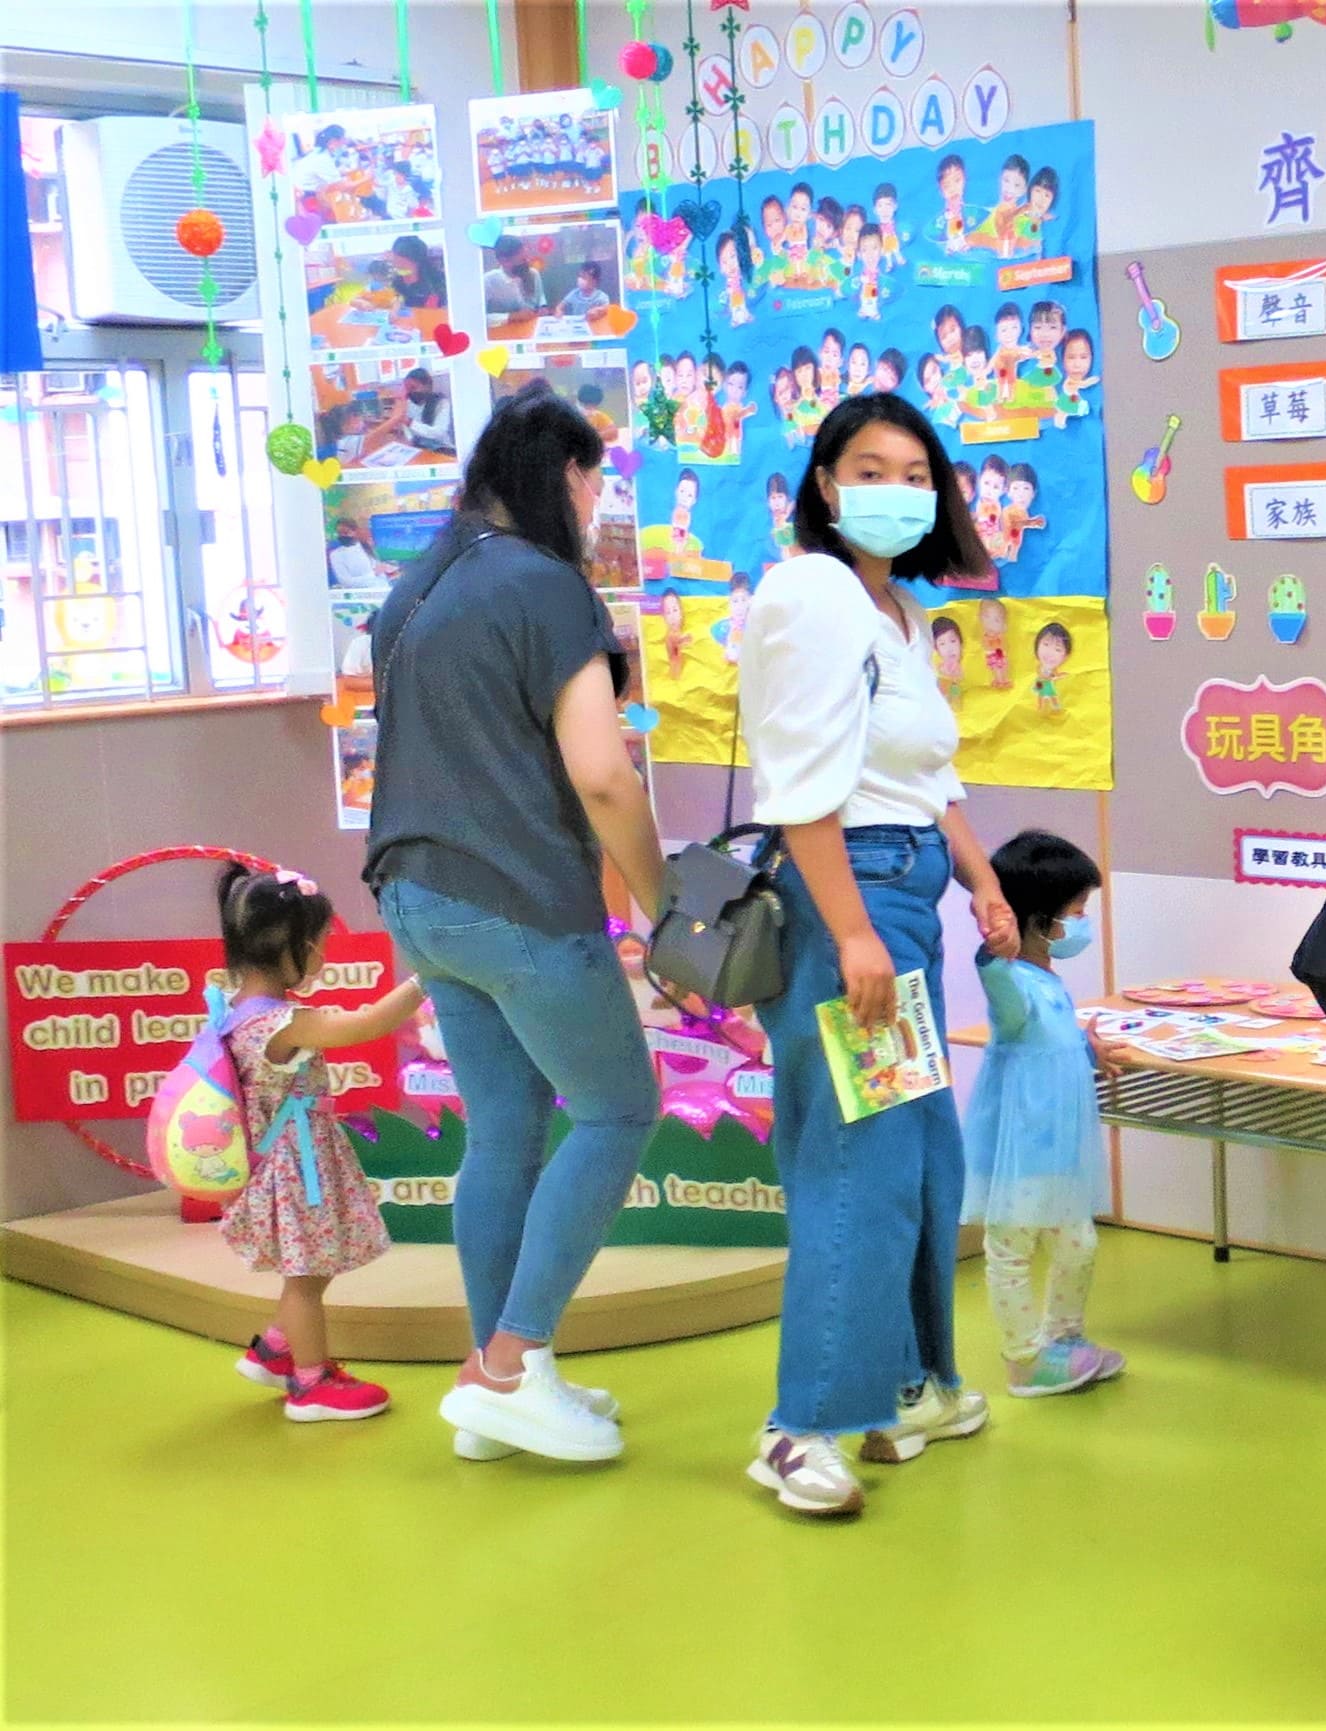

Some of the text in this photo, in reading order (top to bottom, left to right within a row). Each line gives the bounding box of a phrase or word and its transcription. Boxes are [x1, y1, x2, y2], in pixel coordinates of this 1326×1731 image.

[703, 17, 915, 107] HAPPY
[645, 84, 999, 178] BRTHDAY
[1258, 389, 1310, 424] 草莓
[1264, 498, 1318, 528] 家族
[19, 967, 76, 994] We
[88, 965, 185, 993] make
[29, 1012, 207, 1045] child lear
[73, 1074, 102, 1099] in
[393, 1181, 449, 1202] are
